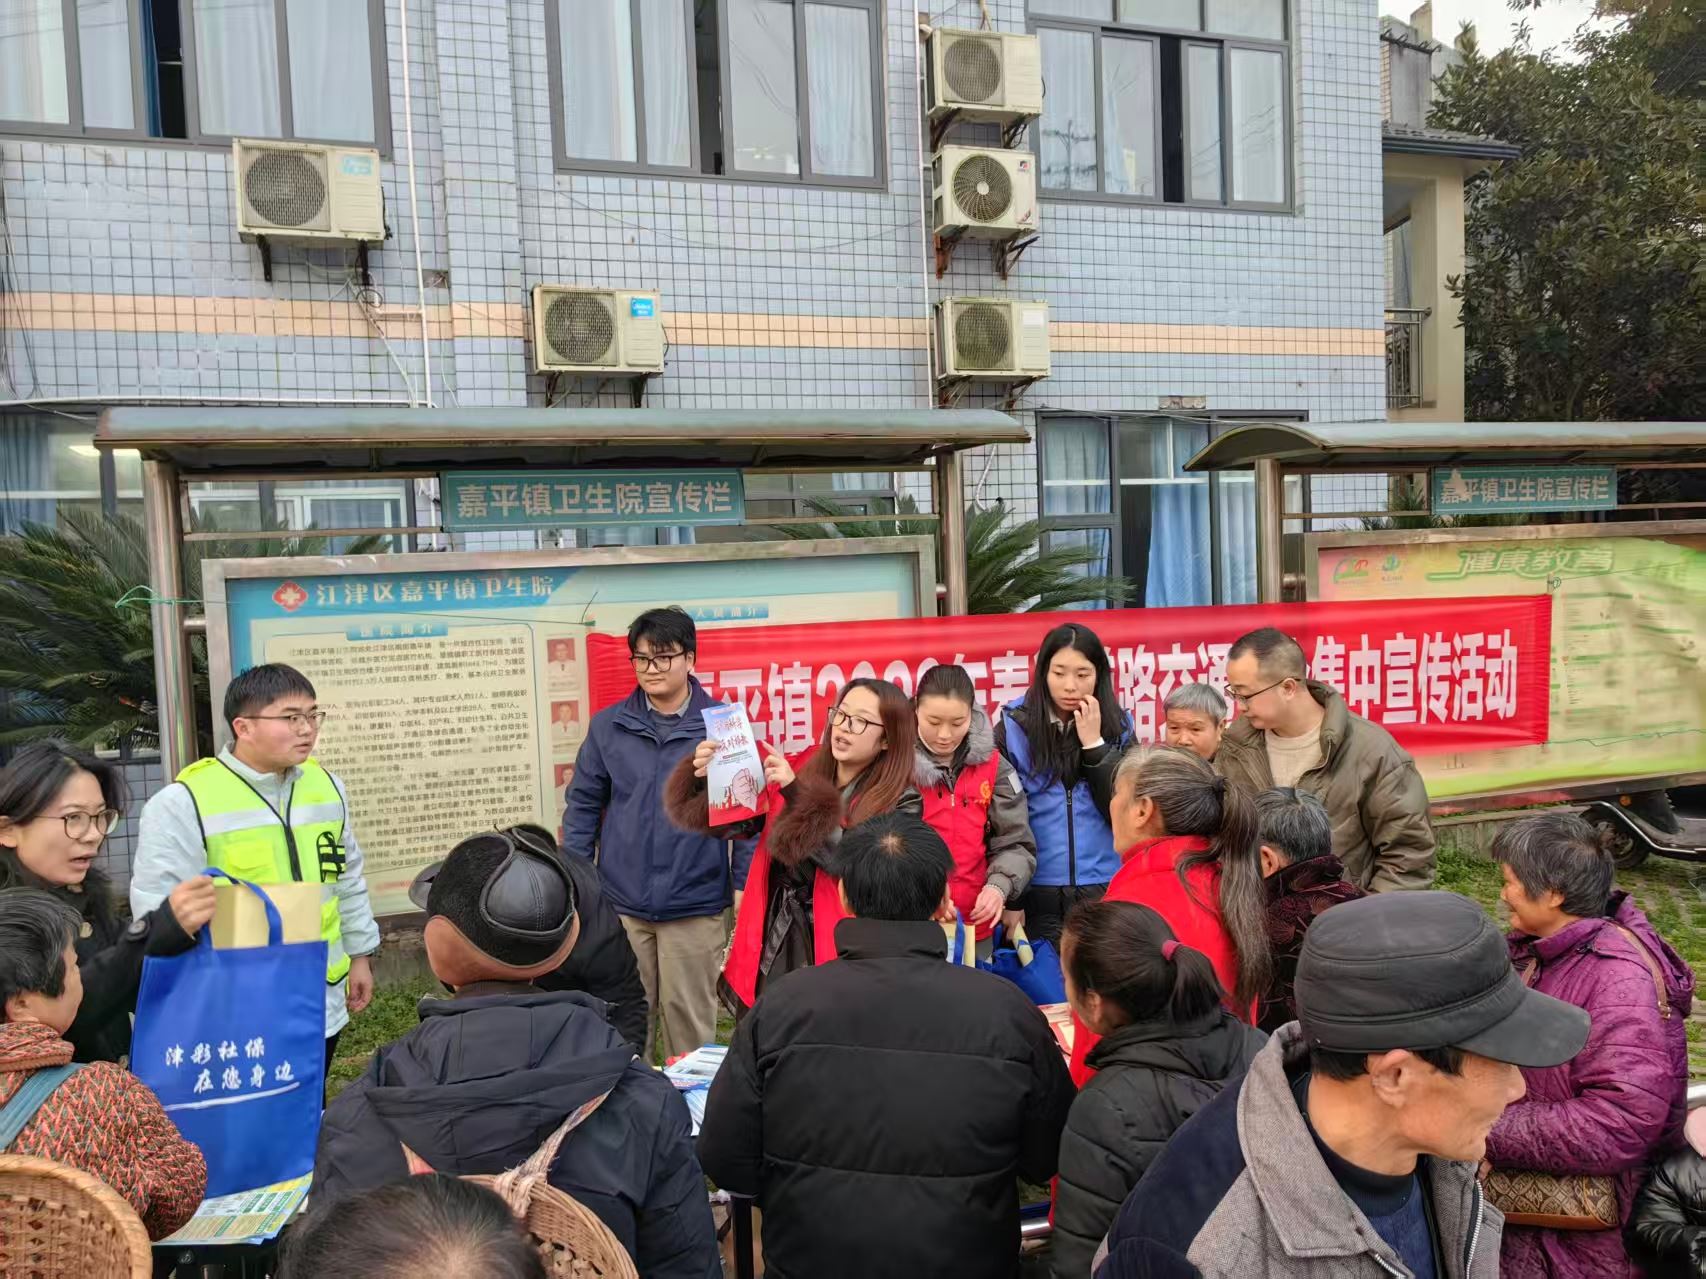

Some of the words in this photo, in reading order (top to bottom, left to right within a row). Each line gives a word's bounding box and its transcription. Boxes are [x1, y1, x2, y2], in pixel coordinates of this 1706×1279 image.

[456, 480, 733, 519] 嘉平镇卫生院宣传栏
[1456, 547, 1615, 578] 健康教育
[315, 575, 554, 606] 江津区嘉平镇卫生院
[164, 1036, 266, 1069] 津彩社保
[193, 1060, 295, 1094] 在您身边
